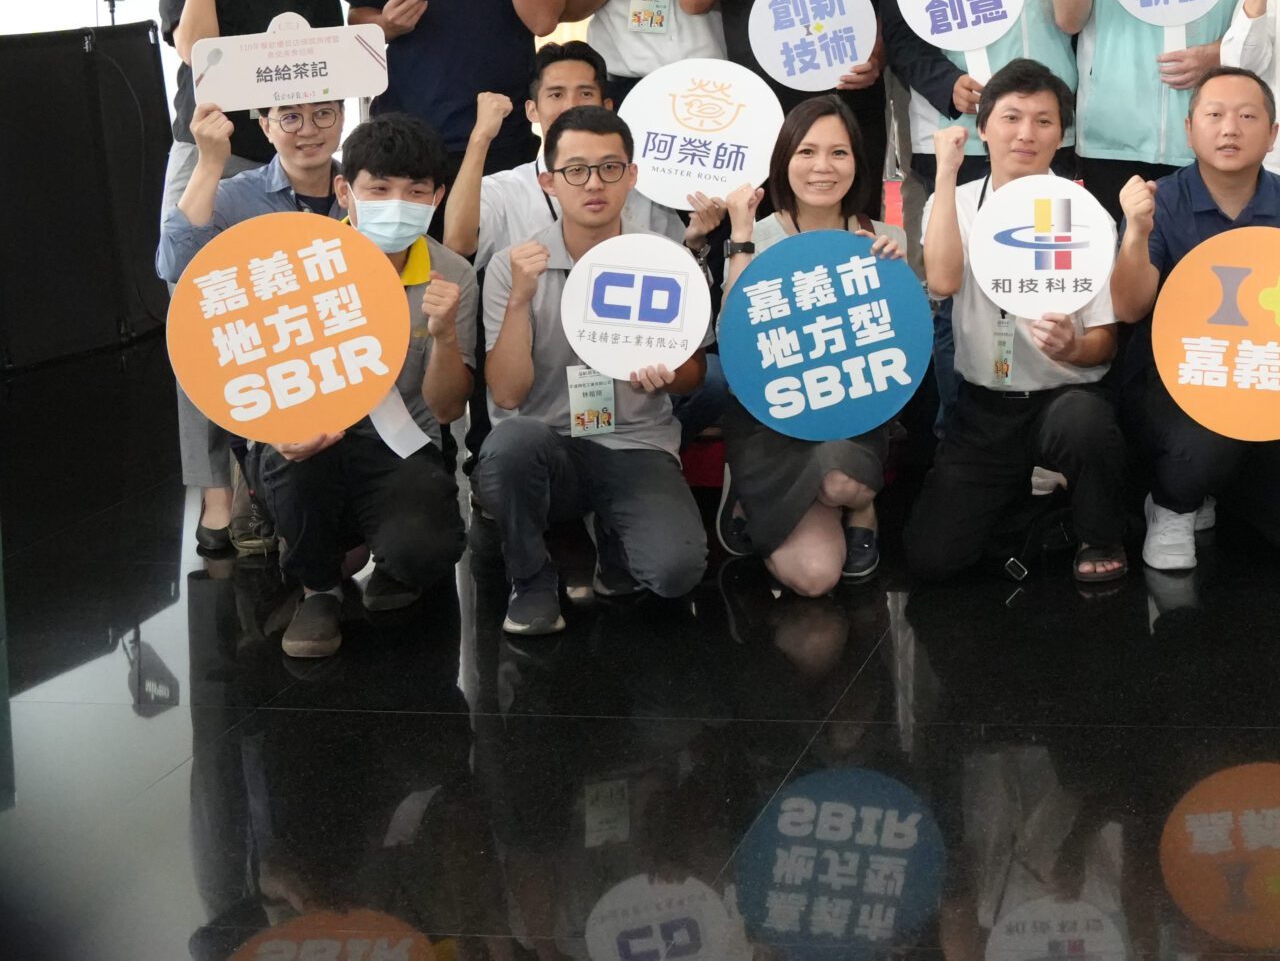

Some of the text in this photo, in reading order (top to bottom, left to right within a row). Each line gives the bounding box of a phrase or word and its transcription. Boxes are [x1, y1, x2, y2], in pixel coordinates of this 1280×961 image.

[256, 61, 329, 83] 給給茶記
[780, 26, 859, 78] 技術
[642, 131, 749, 171] 阿榮師
[651, 166, 728, 183] MASTER RONG
[192, 238, 348, 319] 嘉義市
[591, 271, 682, 324] CD
[743, 255, 881, 325] 嘉義市
[991, 277, 1093, 293] 和技科技
[211, 284, 367, 367] 地方型
[757, 299, 896, 369] 地方型
[223, 335, 389, 423] SBIR
[764, 347, 912, 420] SBIR
